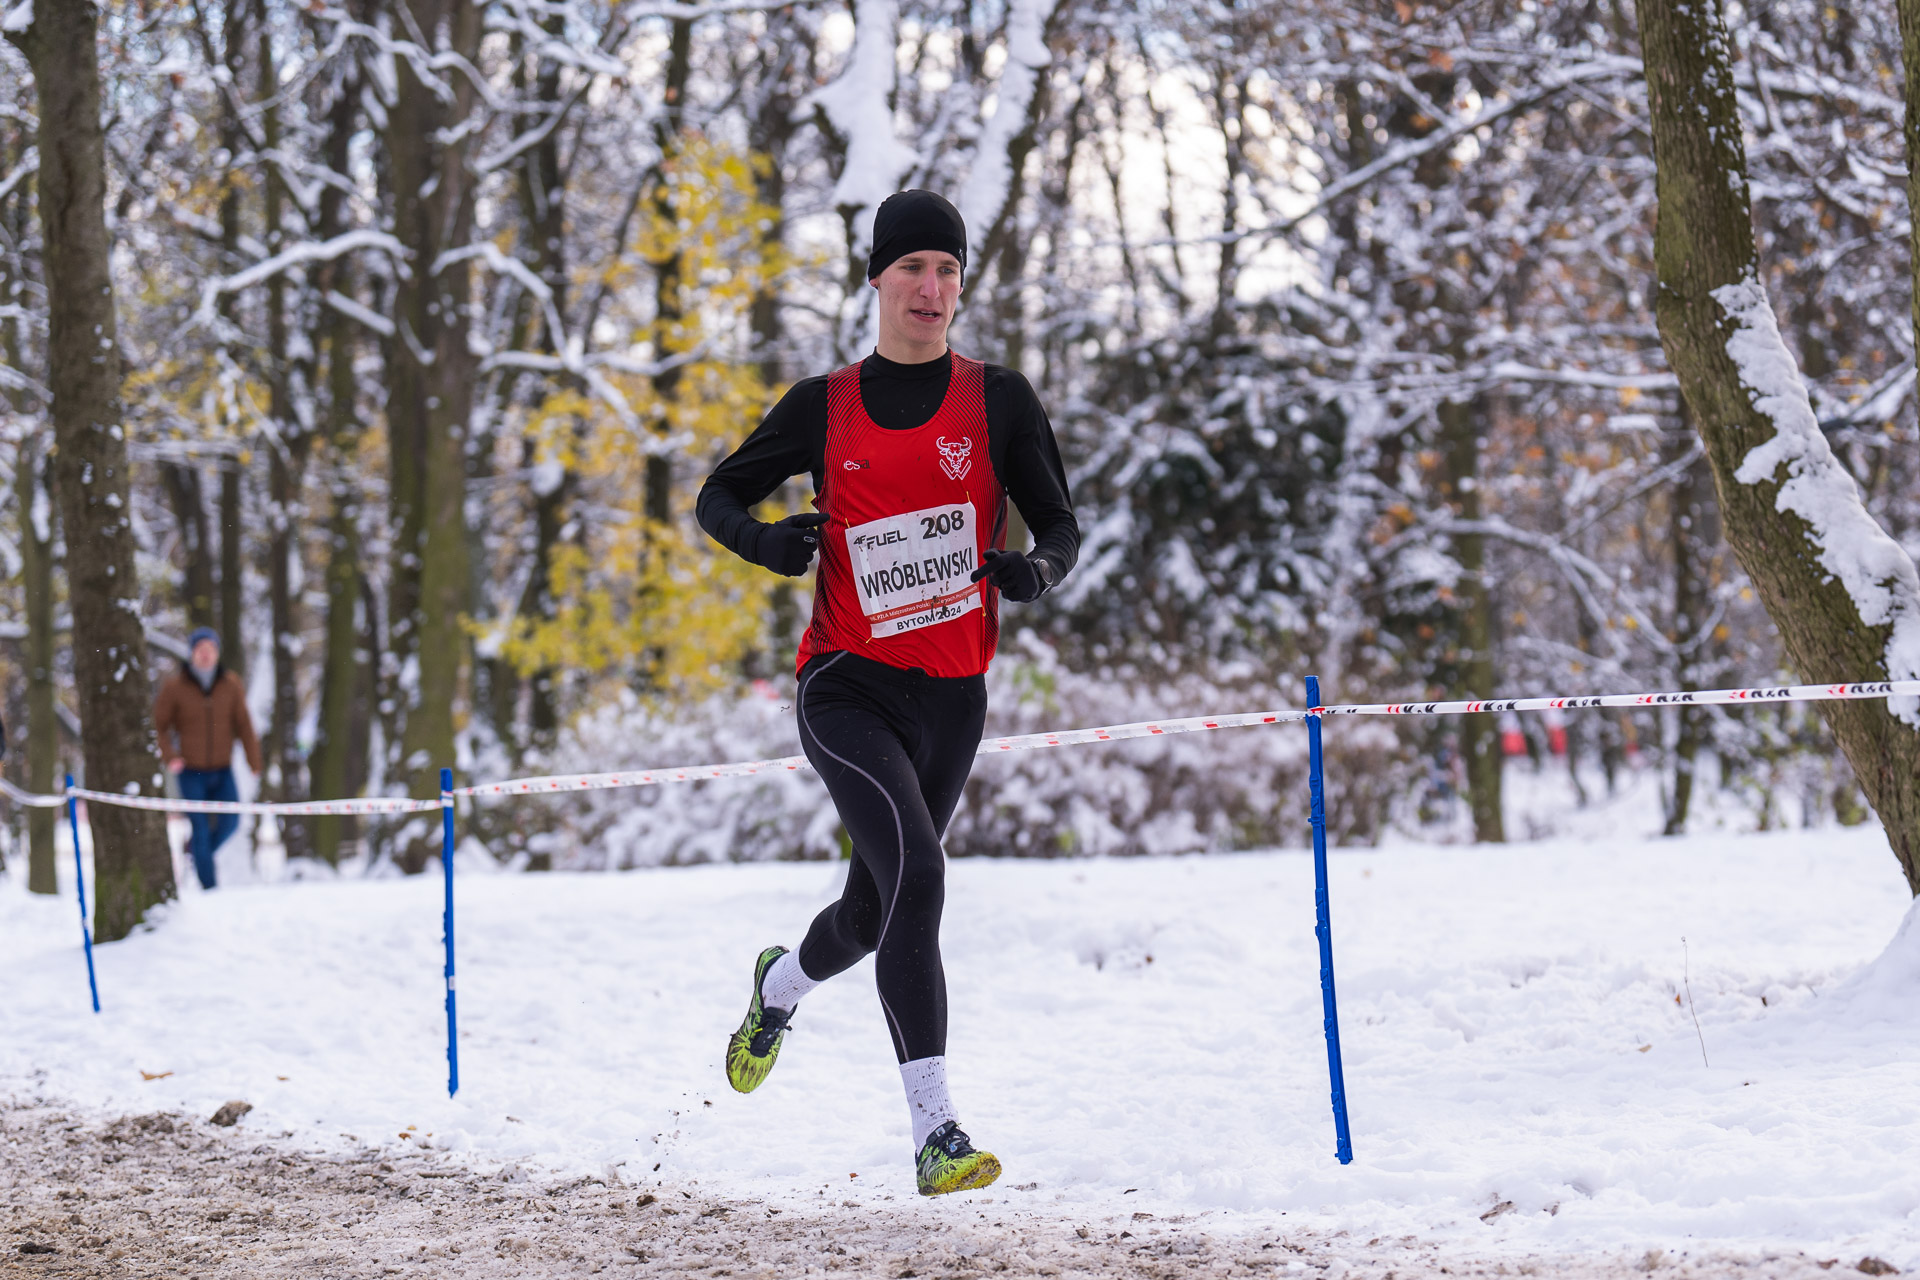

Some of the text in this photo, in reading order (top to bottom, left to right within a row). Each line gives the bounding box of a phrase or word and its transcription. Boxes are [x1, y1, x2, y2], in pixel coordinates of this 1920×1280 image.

[920, 510, 965, 540] 208
[866, 529, 908, 550] FUEL
[860, 546, 973, 599] WRÓBLEWSKI
[897, 605, 962, 630] BYTOM 2024
